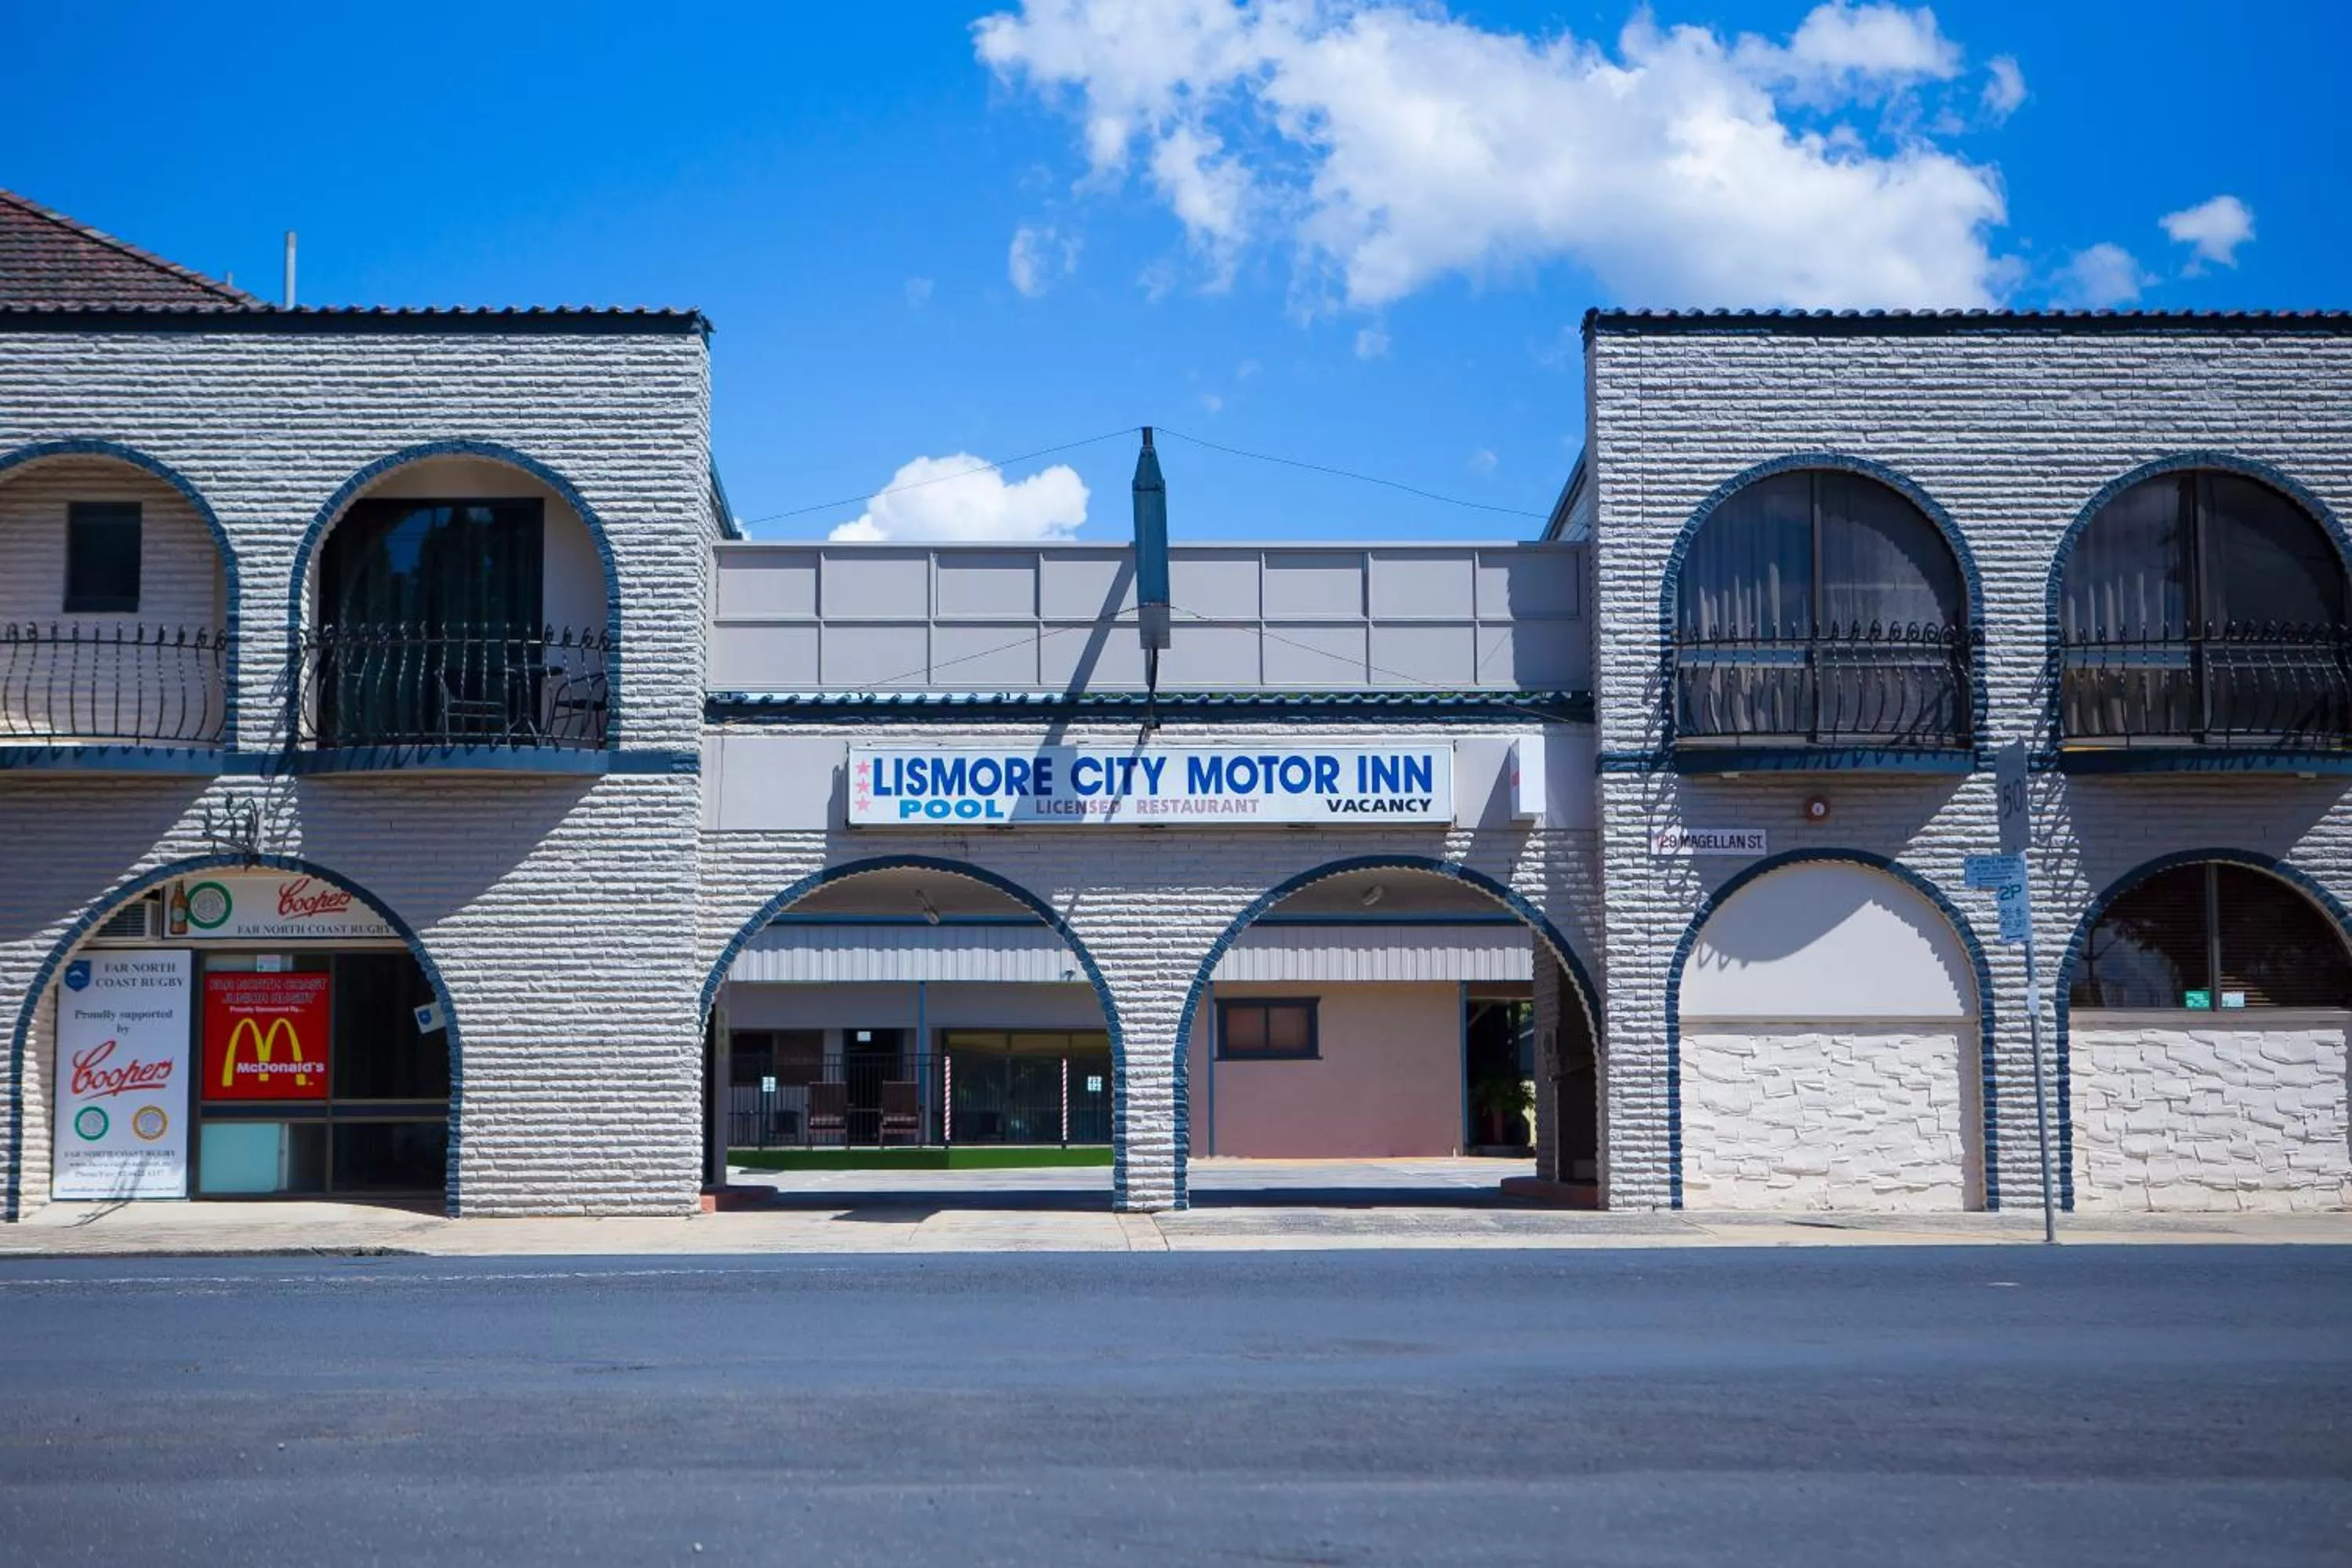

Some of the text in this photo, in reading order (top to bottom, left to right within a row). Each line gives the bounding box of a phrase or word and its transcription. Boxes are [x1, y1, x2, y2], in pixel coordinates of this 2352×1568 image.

[873, 755, 1432, 797] LISMORE CITY MOTOR INN
[2003, 778, 2024, 819] 50
[899, 798, 1432, 818] POOL LICENSED RESTAURANT VACANCY
[1680, 833, 1746, 849] MAGELLAN
[278, 878, 352, 918] Coopers
[1998, 884, 2022, 901] 2P
[238, 924, 390, 935] FAR NORTH COAST RUGBY
[104, 963, 176, 973] FAR NORTH
[95, 978, 184, 988] COAST RUGBY
[74, 1010, 173, 1022] Proudly supported
[117, 1024, 130, 1035] by
[71, 1040, 174, 1100] Coopers
[237, 1062, 325, 1073] McDonald's
